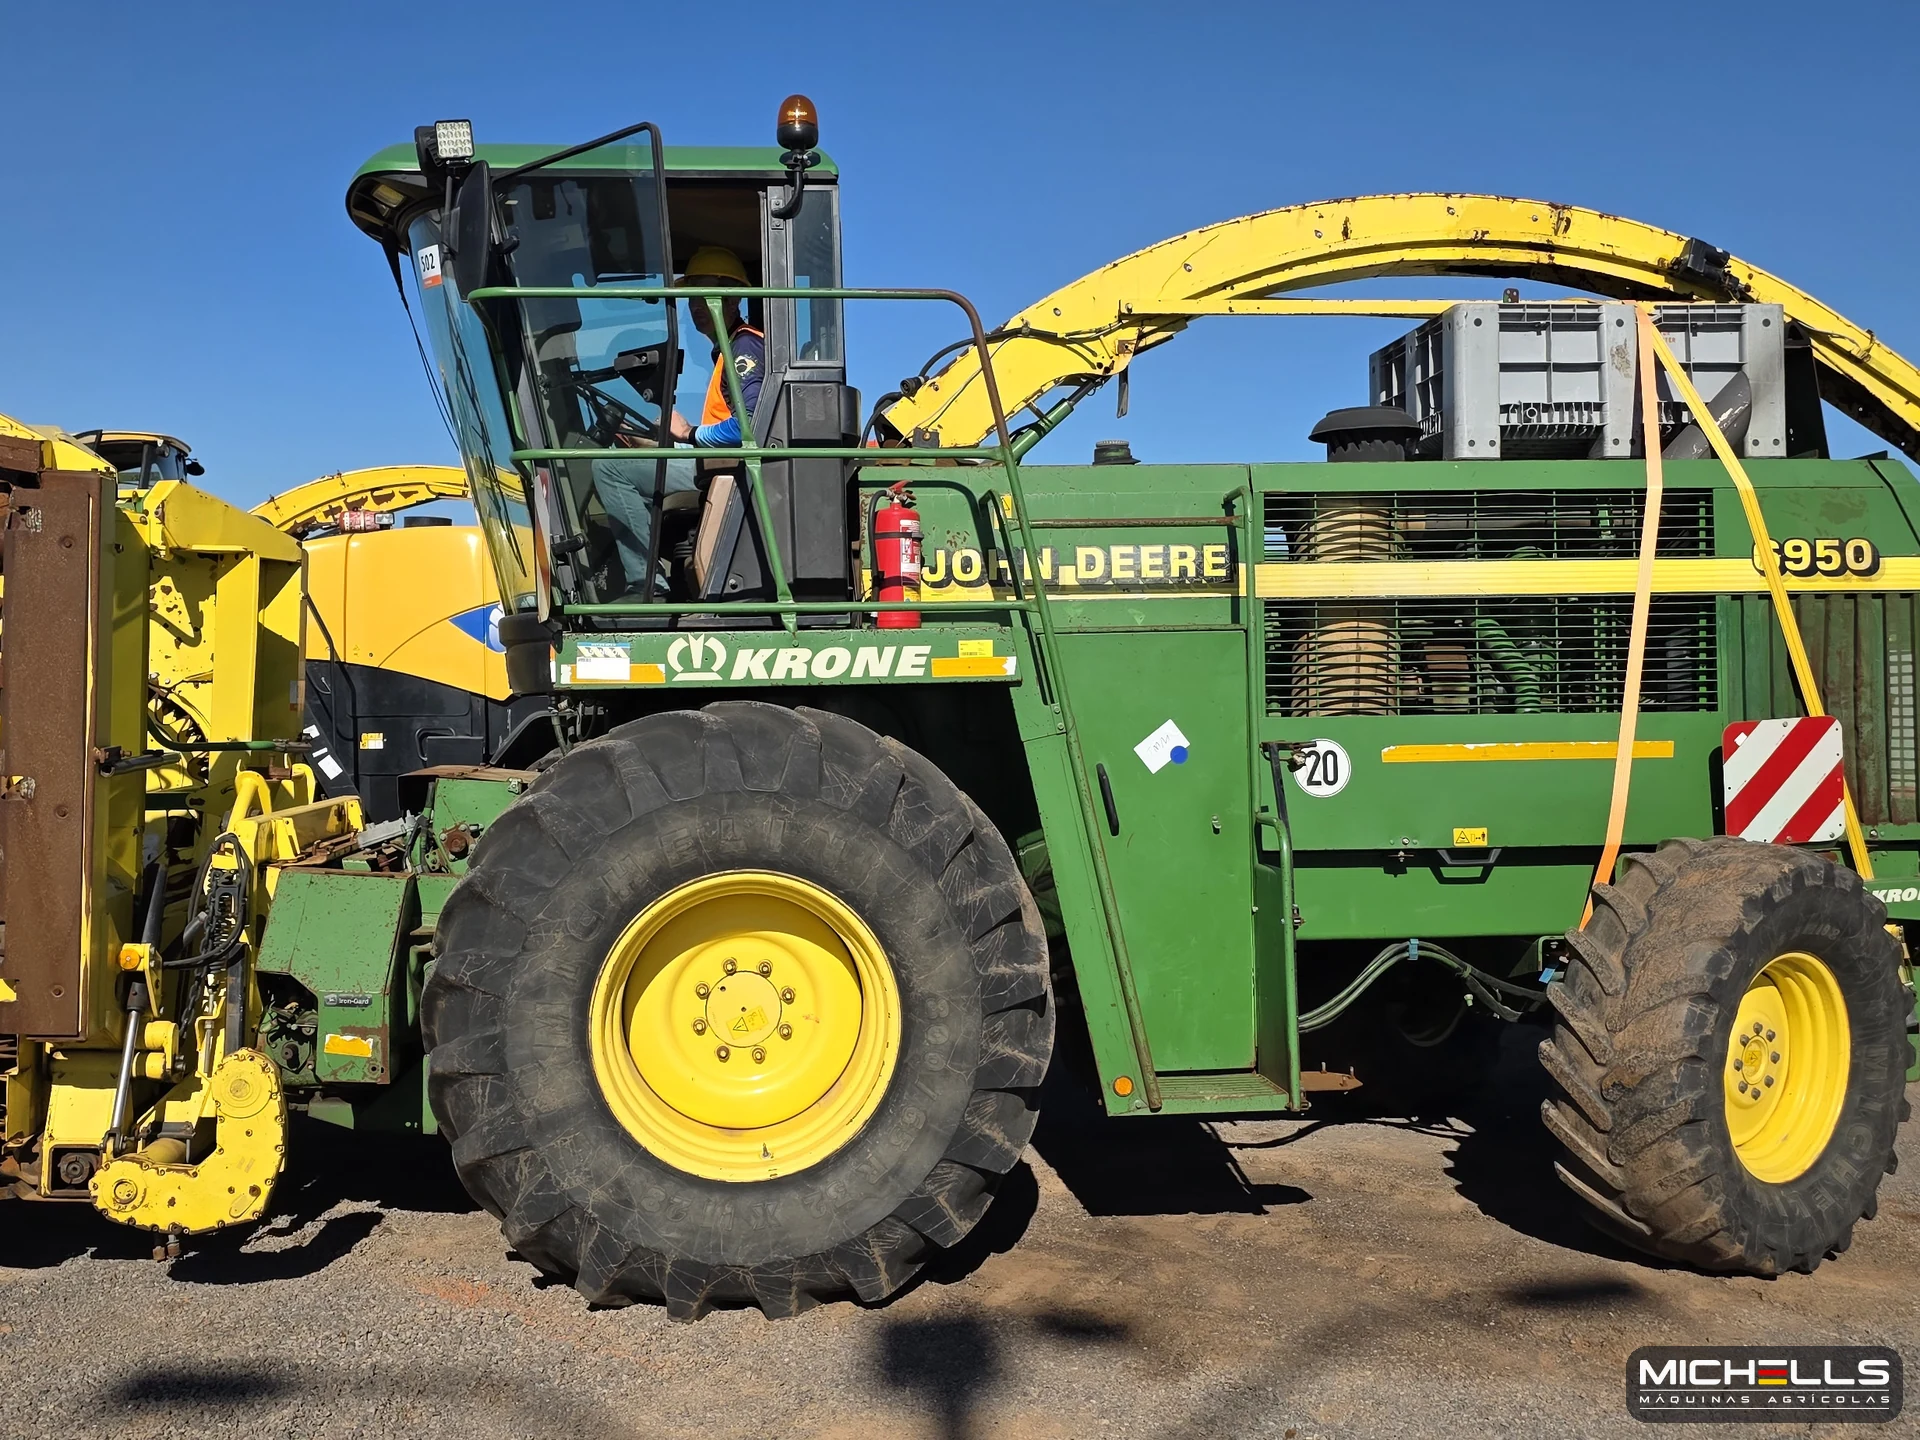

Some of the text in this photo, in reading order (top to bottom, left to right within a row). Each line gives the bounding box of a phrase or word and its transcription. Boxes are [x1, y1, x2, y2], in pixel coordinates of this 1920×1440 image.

[420, 252, 436, 273] 502
[920, 546, 1057, 586] JOHN
[1073, 543, 1232, 584] DEERE
[729, 645, 932, 681] KRONE
[1305, 749, 1339, 786] 20
[1871, 887, 1920, 904] KRO
